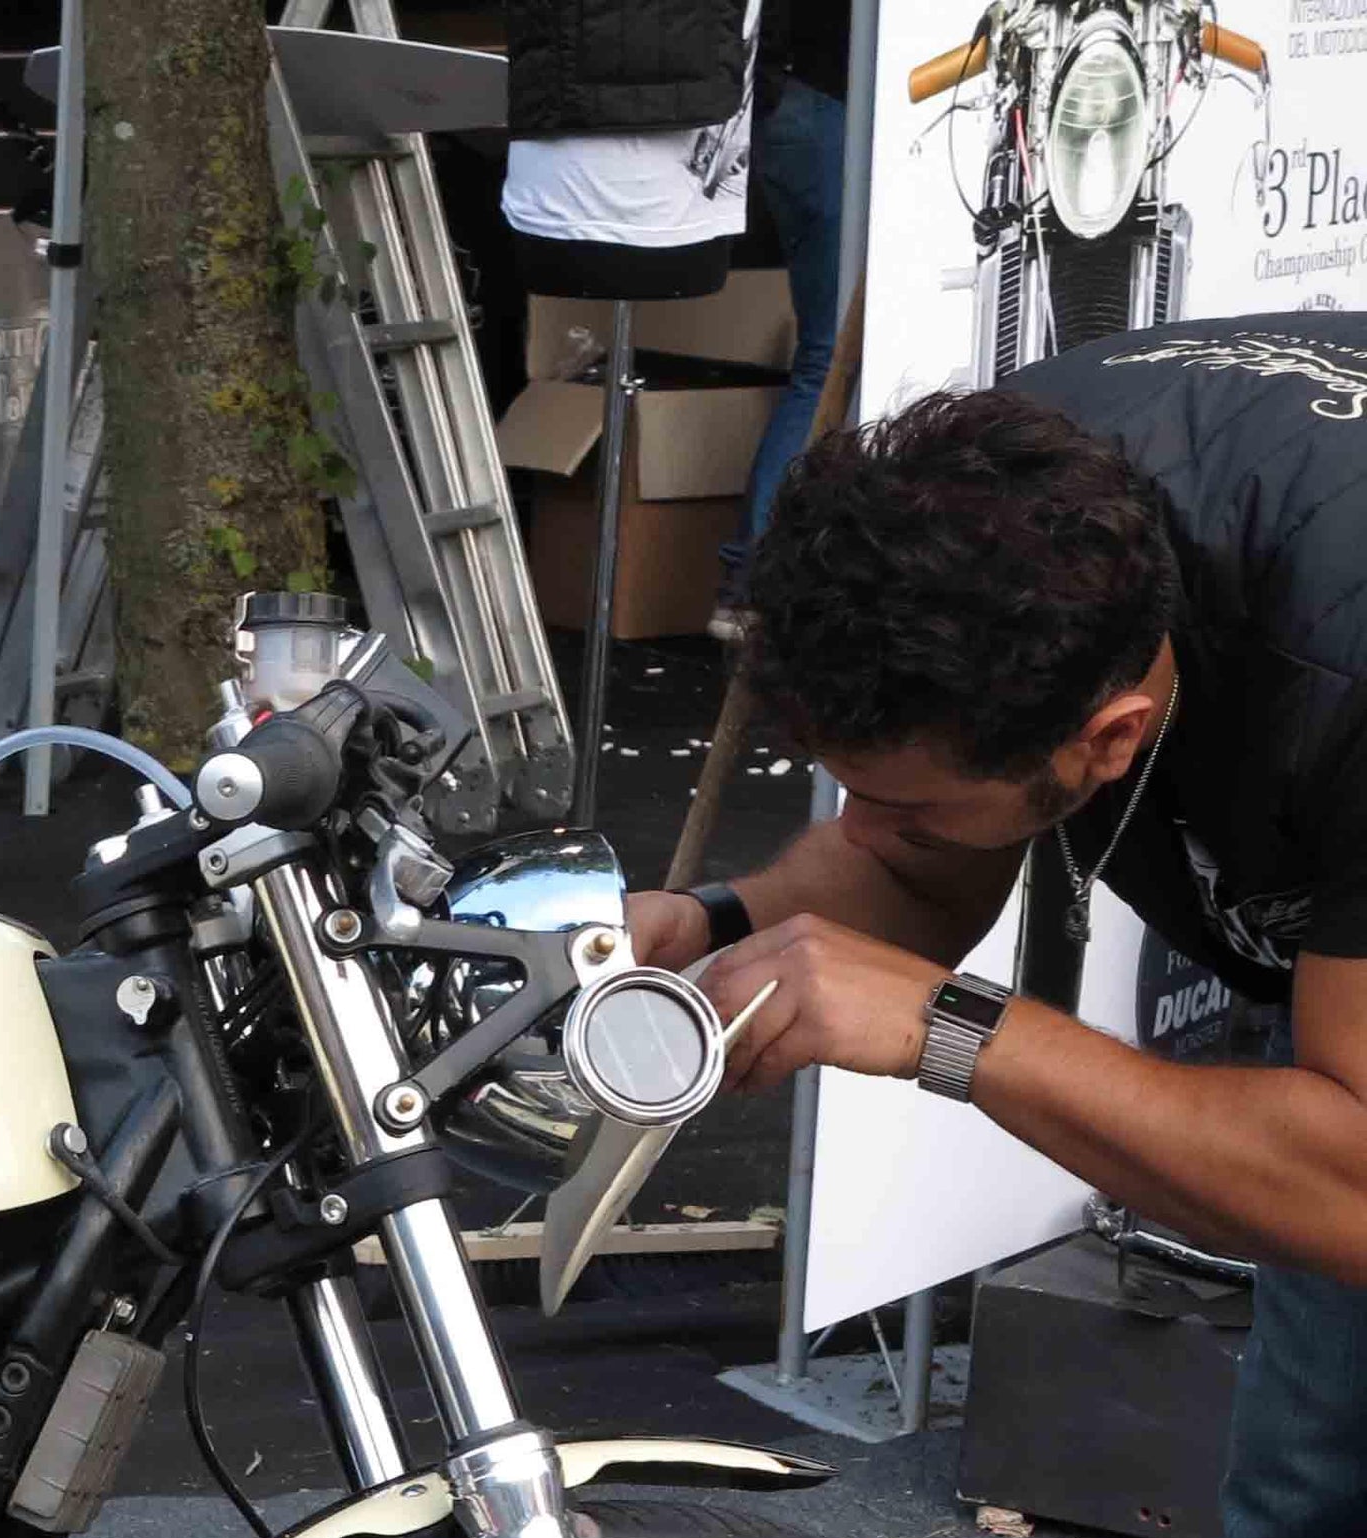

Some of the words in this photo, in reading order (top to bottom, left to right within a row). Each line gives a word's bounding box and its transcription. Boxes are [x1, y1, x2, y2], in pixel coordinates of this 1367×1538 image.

[1303, 148, 1367, 230] Pla
[1253, 236, 1356, 285] Championship
[1152, 975, 1232, 1038] DUCA
